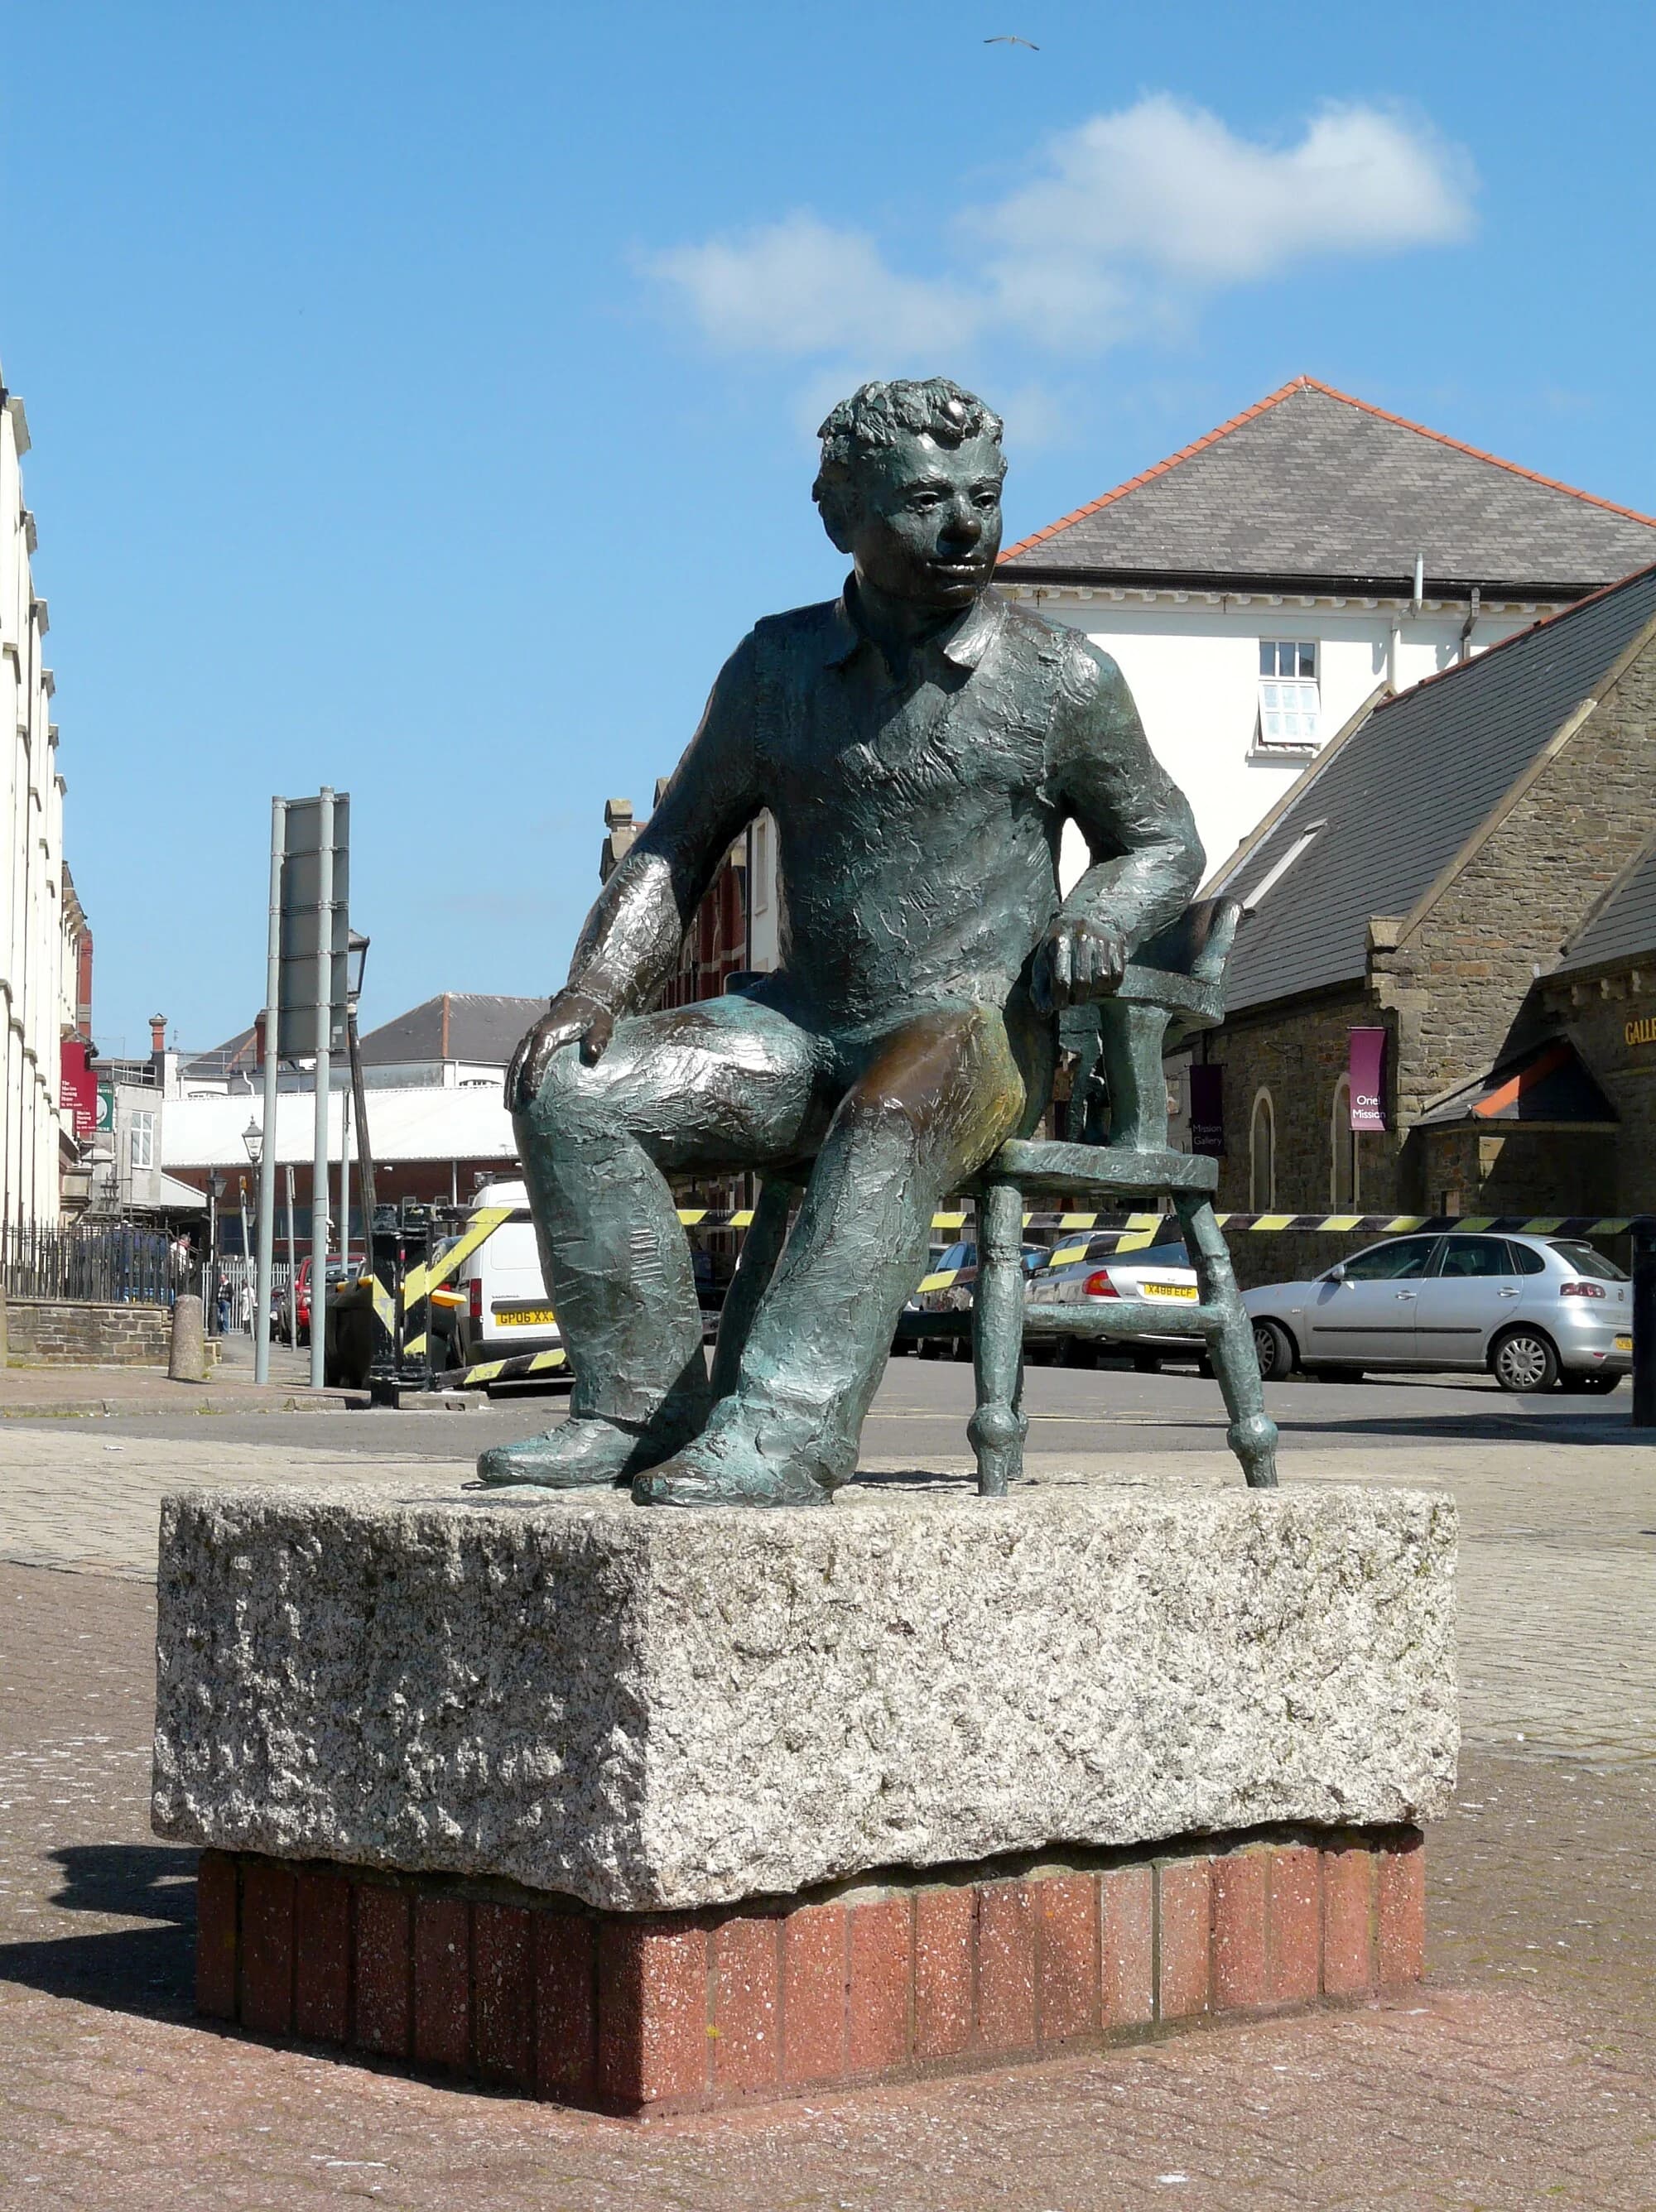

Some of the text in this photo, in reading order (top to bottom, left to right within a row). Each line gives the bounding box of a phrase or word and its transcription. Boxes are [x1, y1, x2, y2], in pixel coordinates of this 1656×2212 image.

[1356, 1095, 1381, 1105] Oriel
[1352, 1108, 1386, 1118] Mission
[1192, 1123, 1222, 1133] Mission
[1193, 1135, 1223, 1147] Gallery
[500, 1311, 531, 1324] GP06
